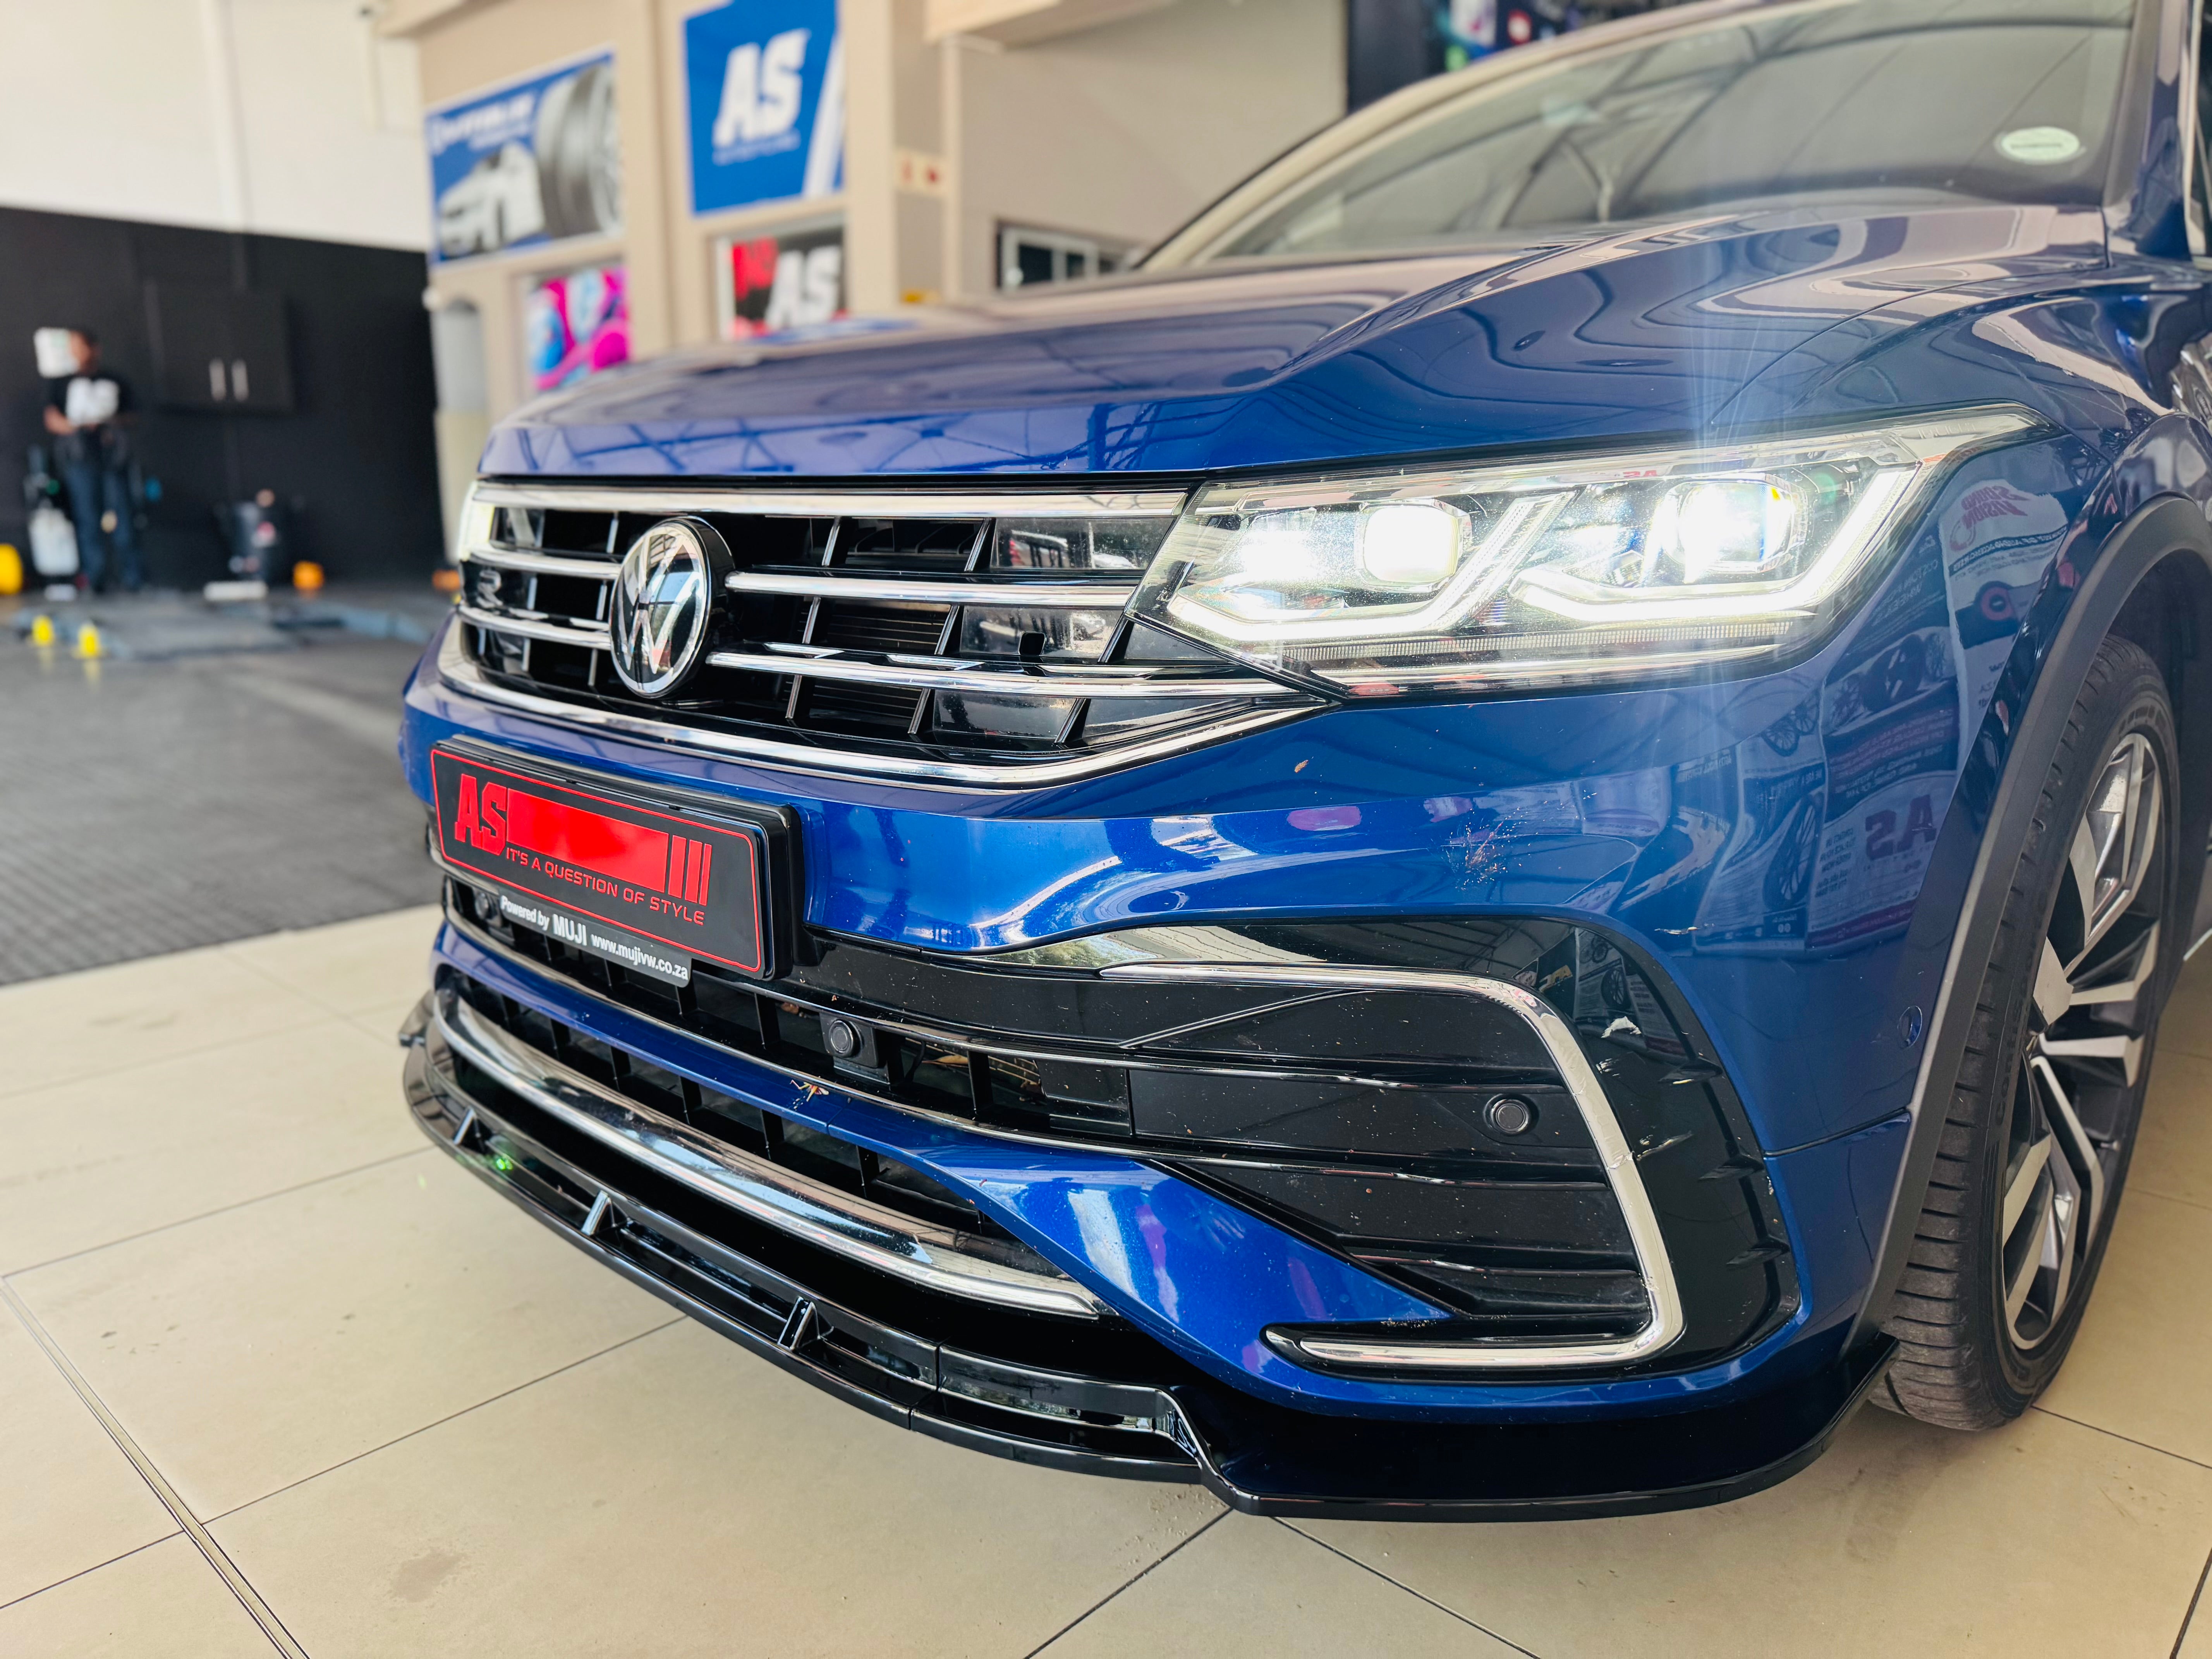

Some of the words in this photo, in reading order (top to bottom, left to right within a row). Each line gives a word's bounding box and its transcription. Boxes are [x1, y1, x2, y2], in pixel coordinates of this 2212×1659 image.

[713, 27, 811, 148] AS
[765, 245, 841, 329] AS
[455, 774, 507, 855] AS
[506, 847, 528, 866] IT'S
[531, 857, 541, 871] A
[545, 861, 618, 897] QUESTION
[623, 888, 645, 904] OF
[650, 896, 704, 925] STYLE
[501, 897, 536, 922] Powered
[537, 910, 550, 931] by
[552, 914, 587, 946] MUJI
[591, 934, 688, 980] www.mujivw.co.za
